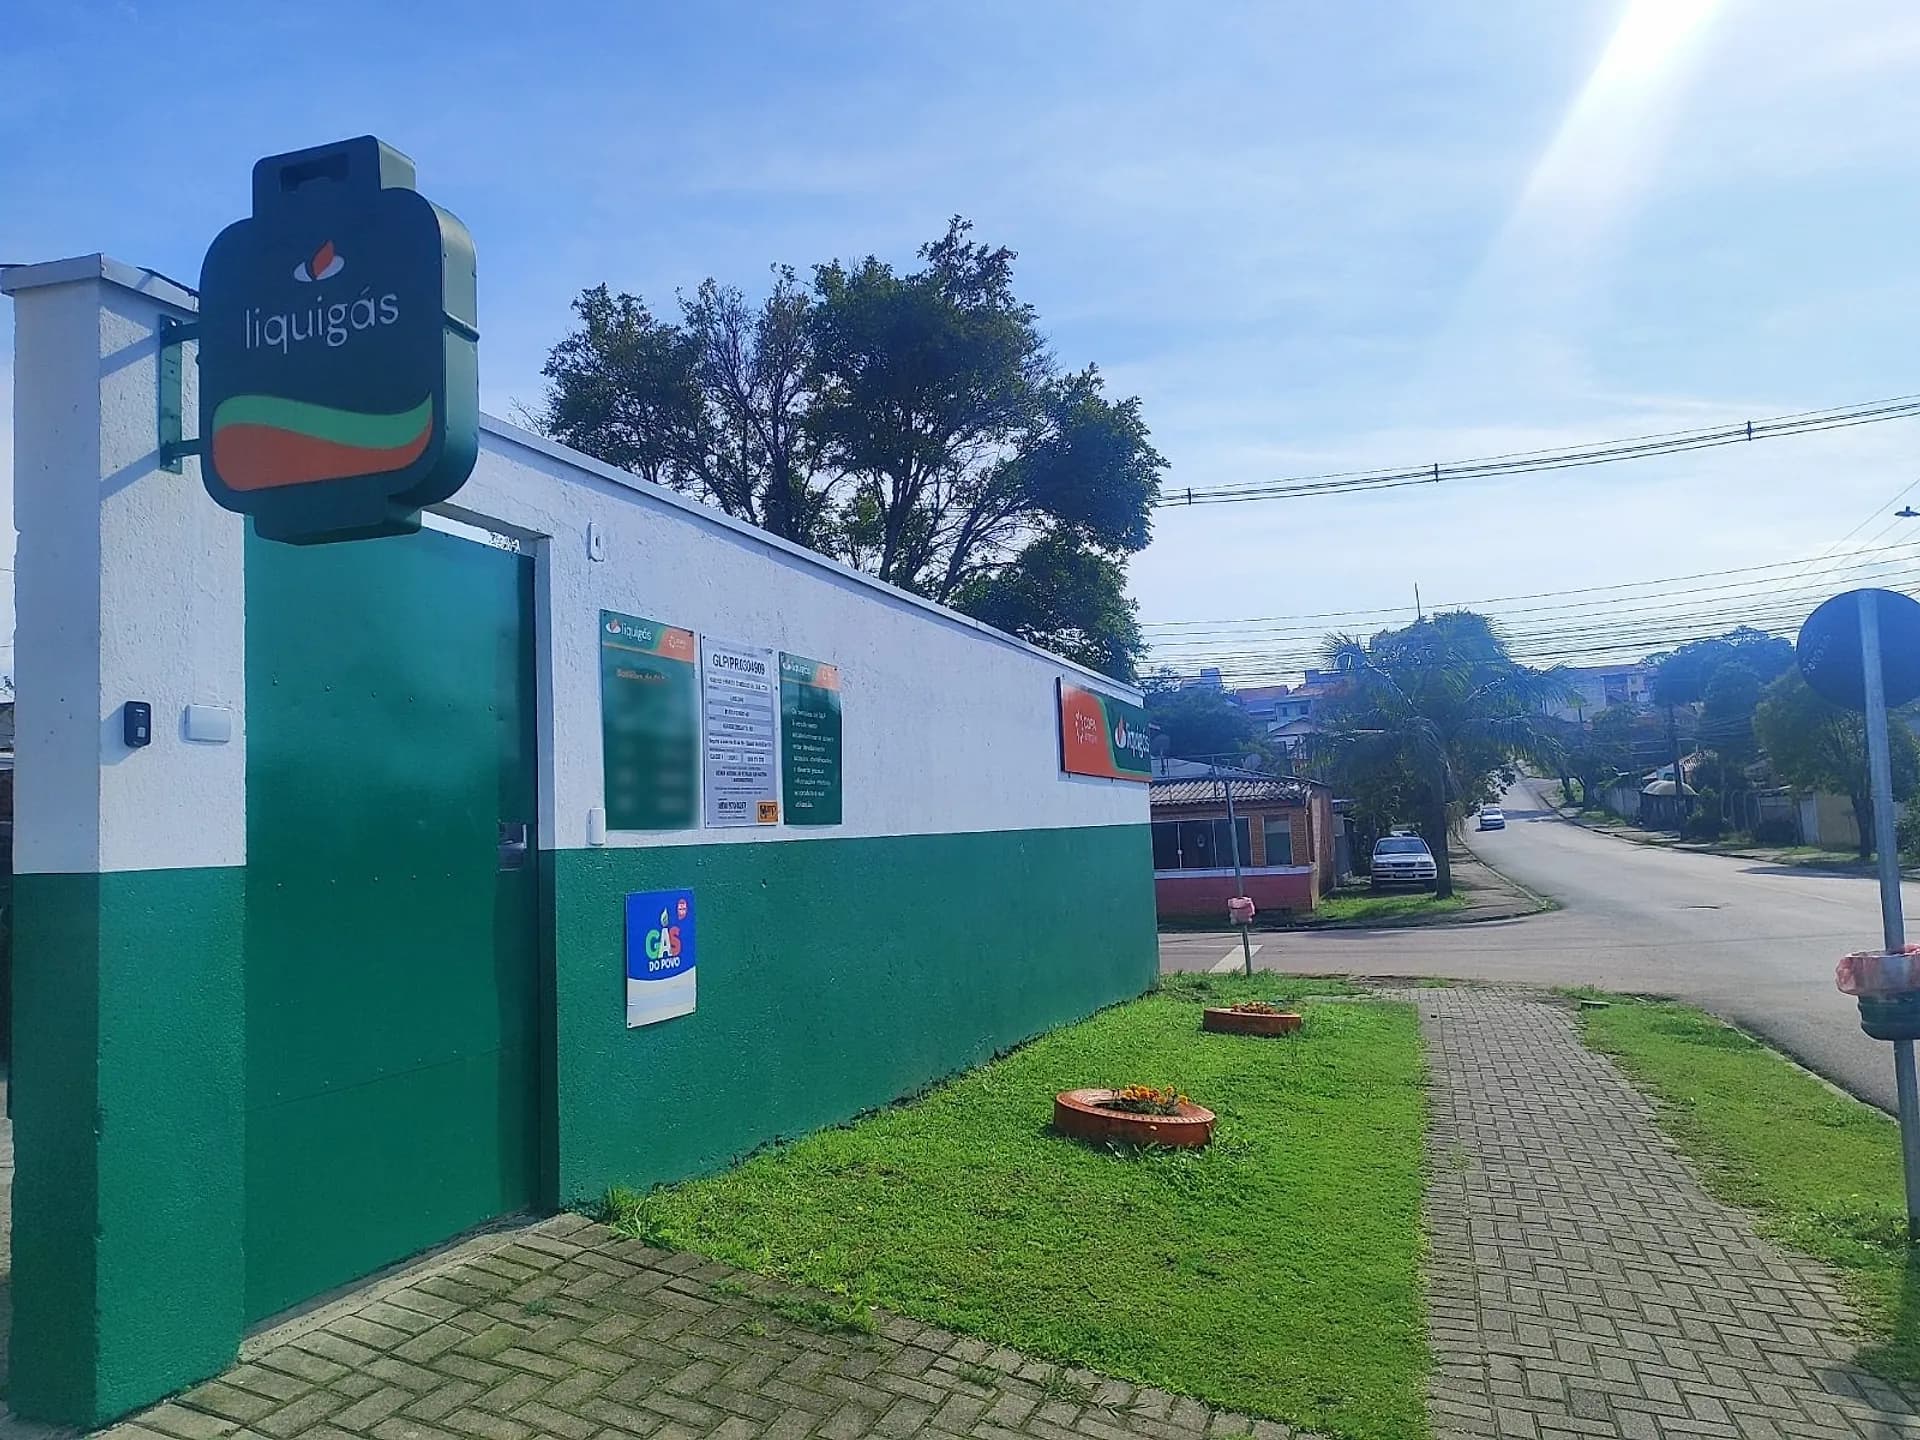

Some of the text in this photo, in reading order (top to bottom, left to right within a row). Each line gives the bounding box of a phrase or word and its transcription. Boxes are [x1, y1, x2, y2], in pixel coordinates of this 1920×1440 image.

[246, 286, 399, 354] liquigás
[649, 956, 681, 972] DO POVO
